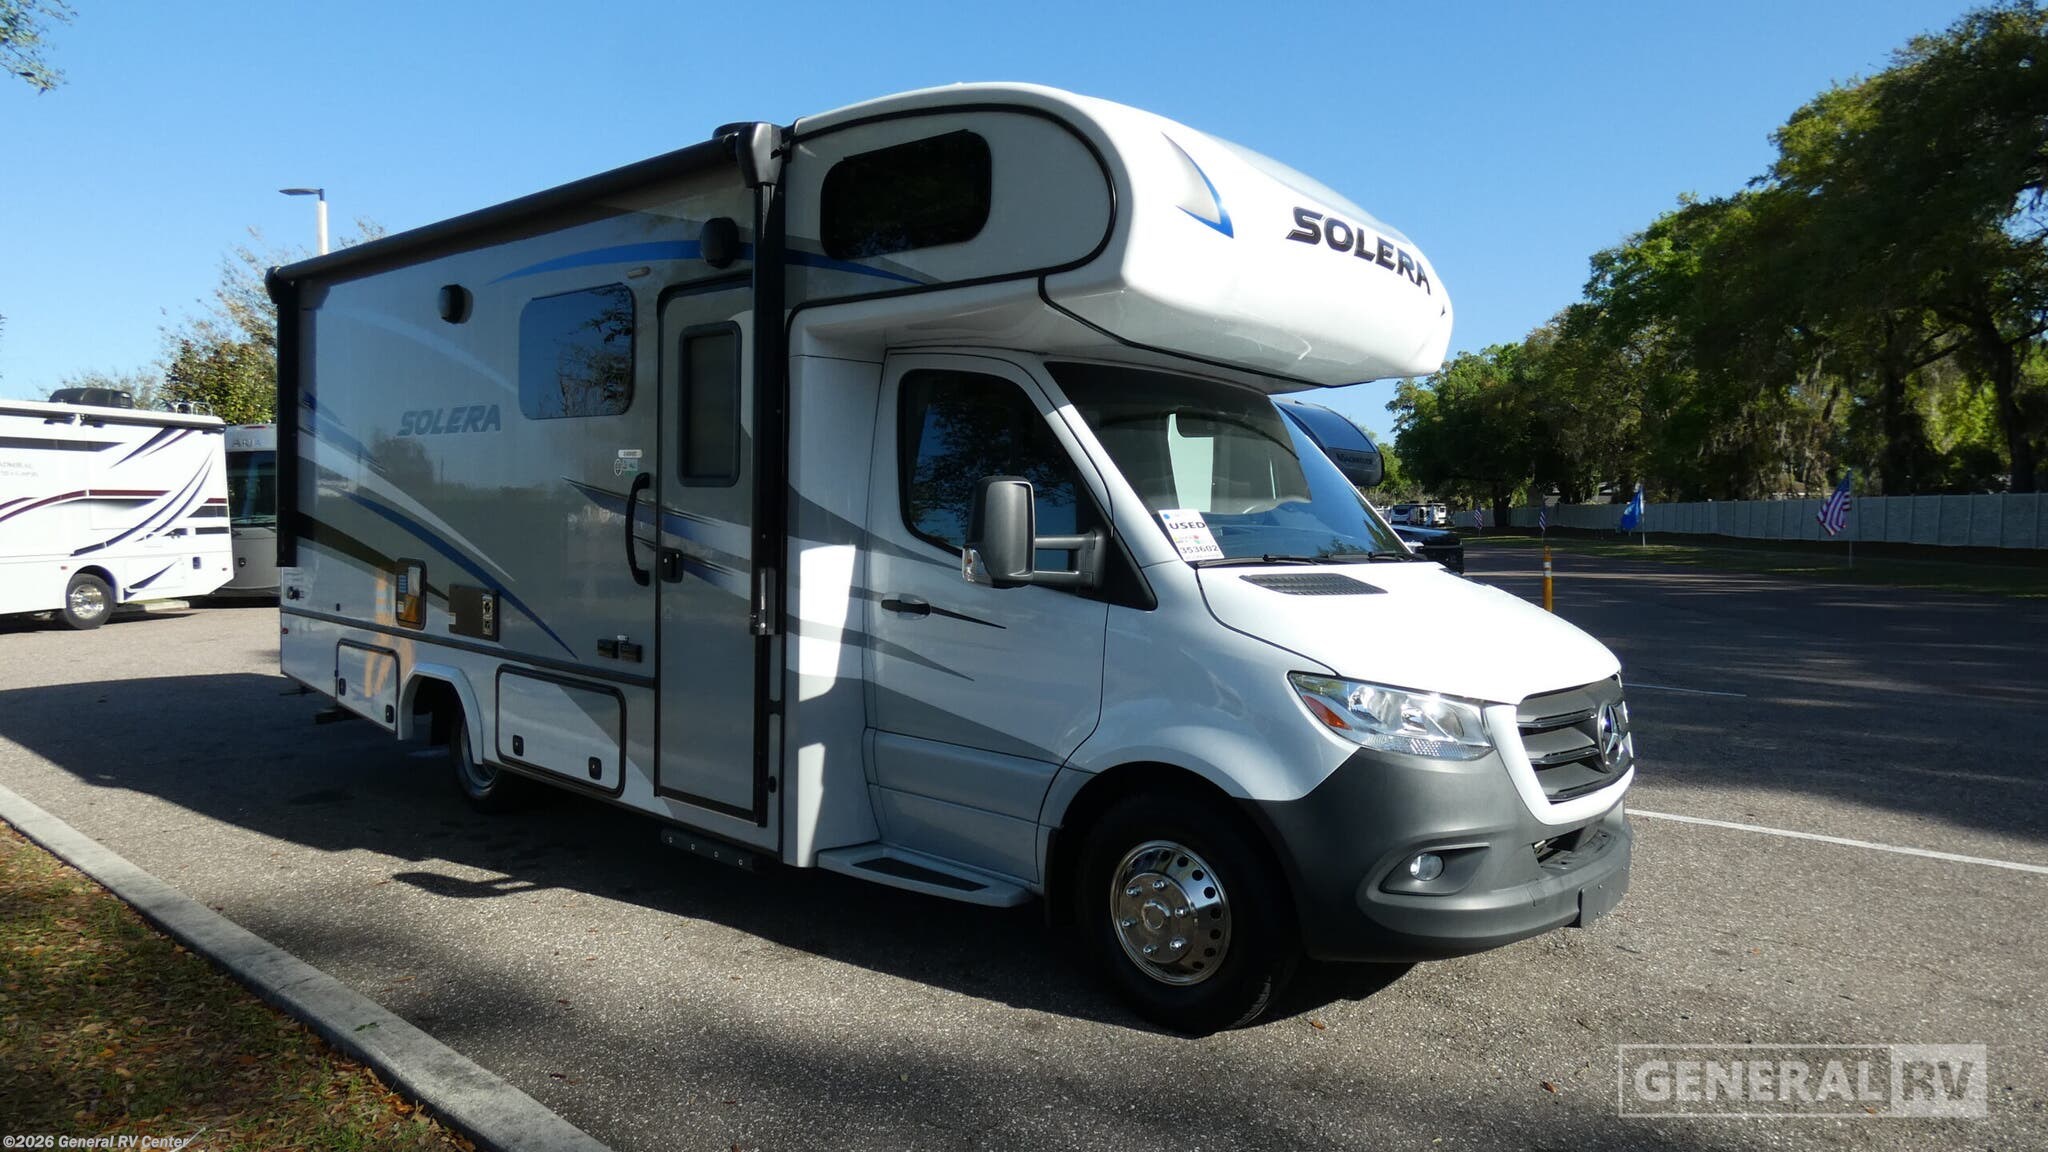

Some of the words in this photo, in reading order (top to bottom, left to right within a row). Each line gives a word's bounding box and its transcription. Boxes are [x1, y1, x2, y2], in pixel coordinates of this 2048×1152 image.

[1286, 206, 1431, 296] SOLERA
[396, 404, 502, 437] SOLERA
[1169, 521, 1206, 529] USED
[1180, 544, 1219, 554] 353602
